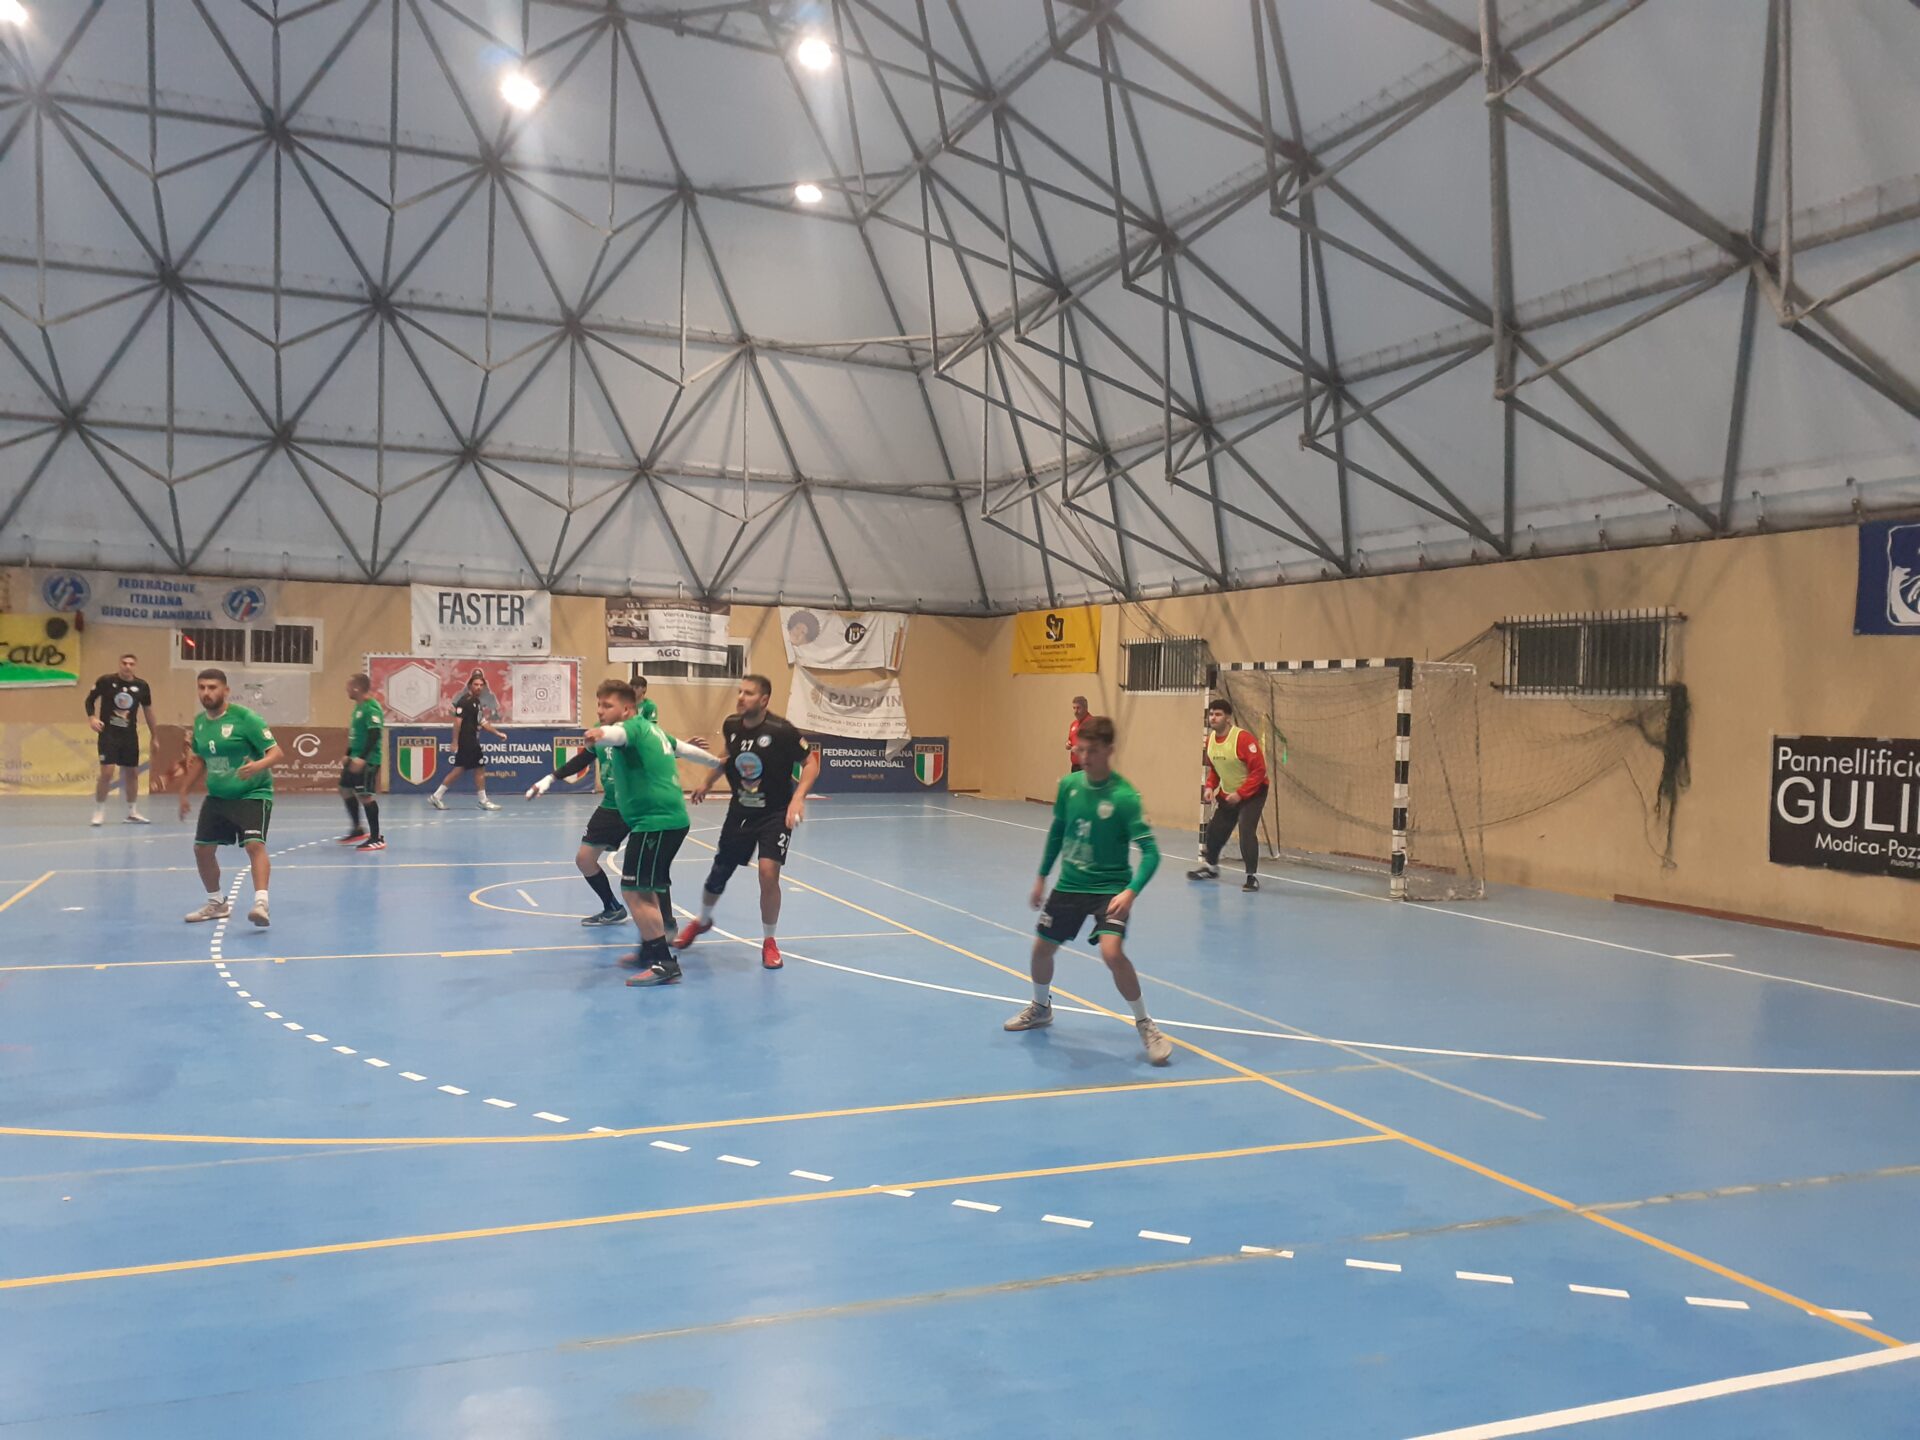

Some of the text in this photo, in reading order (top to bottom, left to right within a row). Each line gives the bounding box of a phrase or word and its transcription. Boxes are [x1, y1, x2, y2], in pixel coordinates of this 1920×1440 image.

[118, 577, 196, 593] FEDERAZIONE
[130, 593, 183, 606] ITALIANA
[101, 606, 149, 618] GIUOCO
[438, 592, 525, 626] FASTER
[208, 740, 216, 754] 8
[508, 743, 553, 753] ITALIANA
[740, 739, 754, 751] 27
[822, 748, 877, 757] FEDERAZIONE
[491, 755, 543, 764] HANDBALL
[829, 758, 906, 769] GIUOCO HANDBALL
[1777, 776, 1920, 835] GULI
